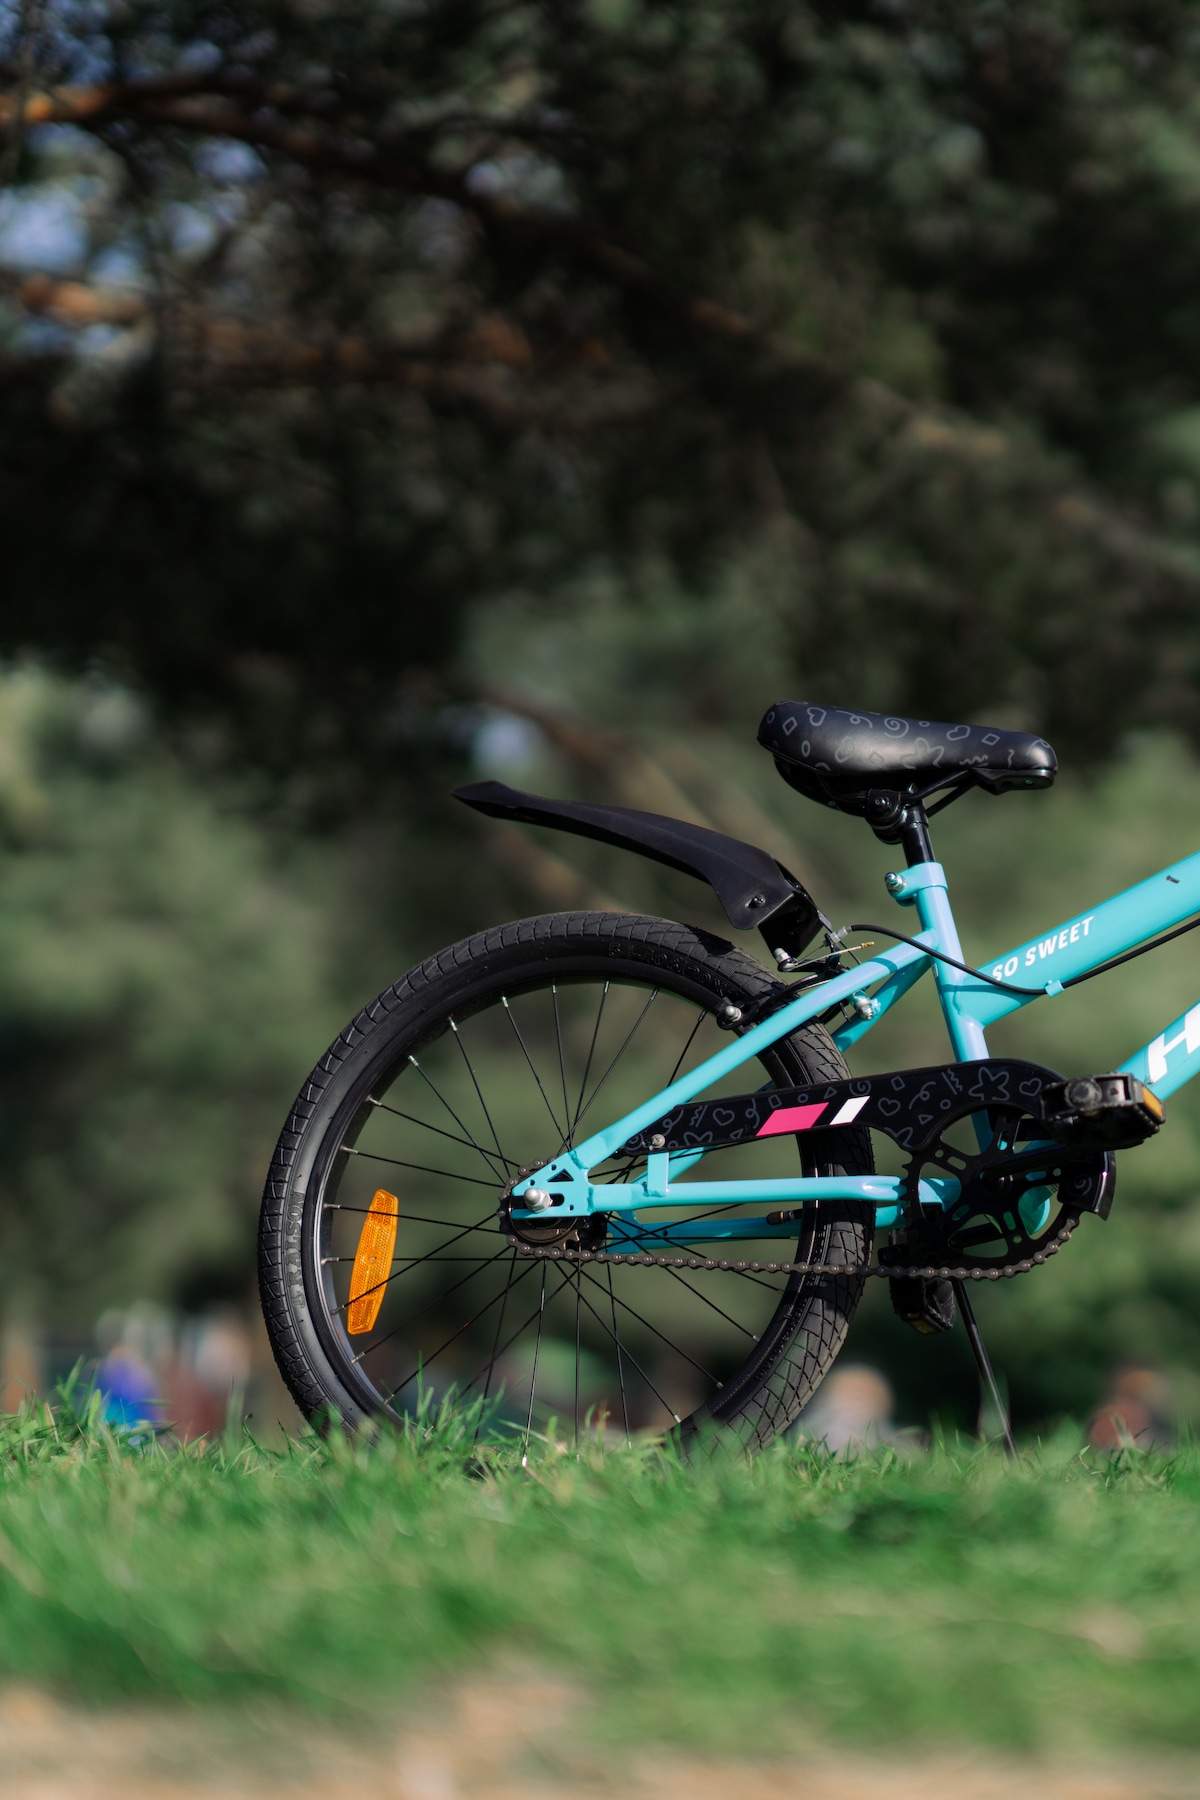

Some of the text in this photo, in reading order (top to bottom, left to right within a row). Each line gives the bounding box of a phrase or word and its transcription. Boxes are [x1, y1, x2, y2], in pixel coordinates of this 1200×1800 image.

[992, 915, 1094, 981] SO SWEET
[286, 1190, 305, 1287] RALSON
